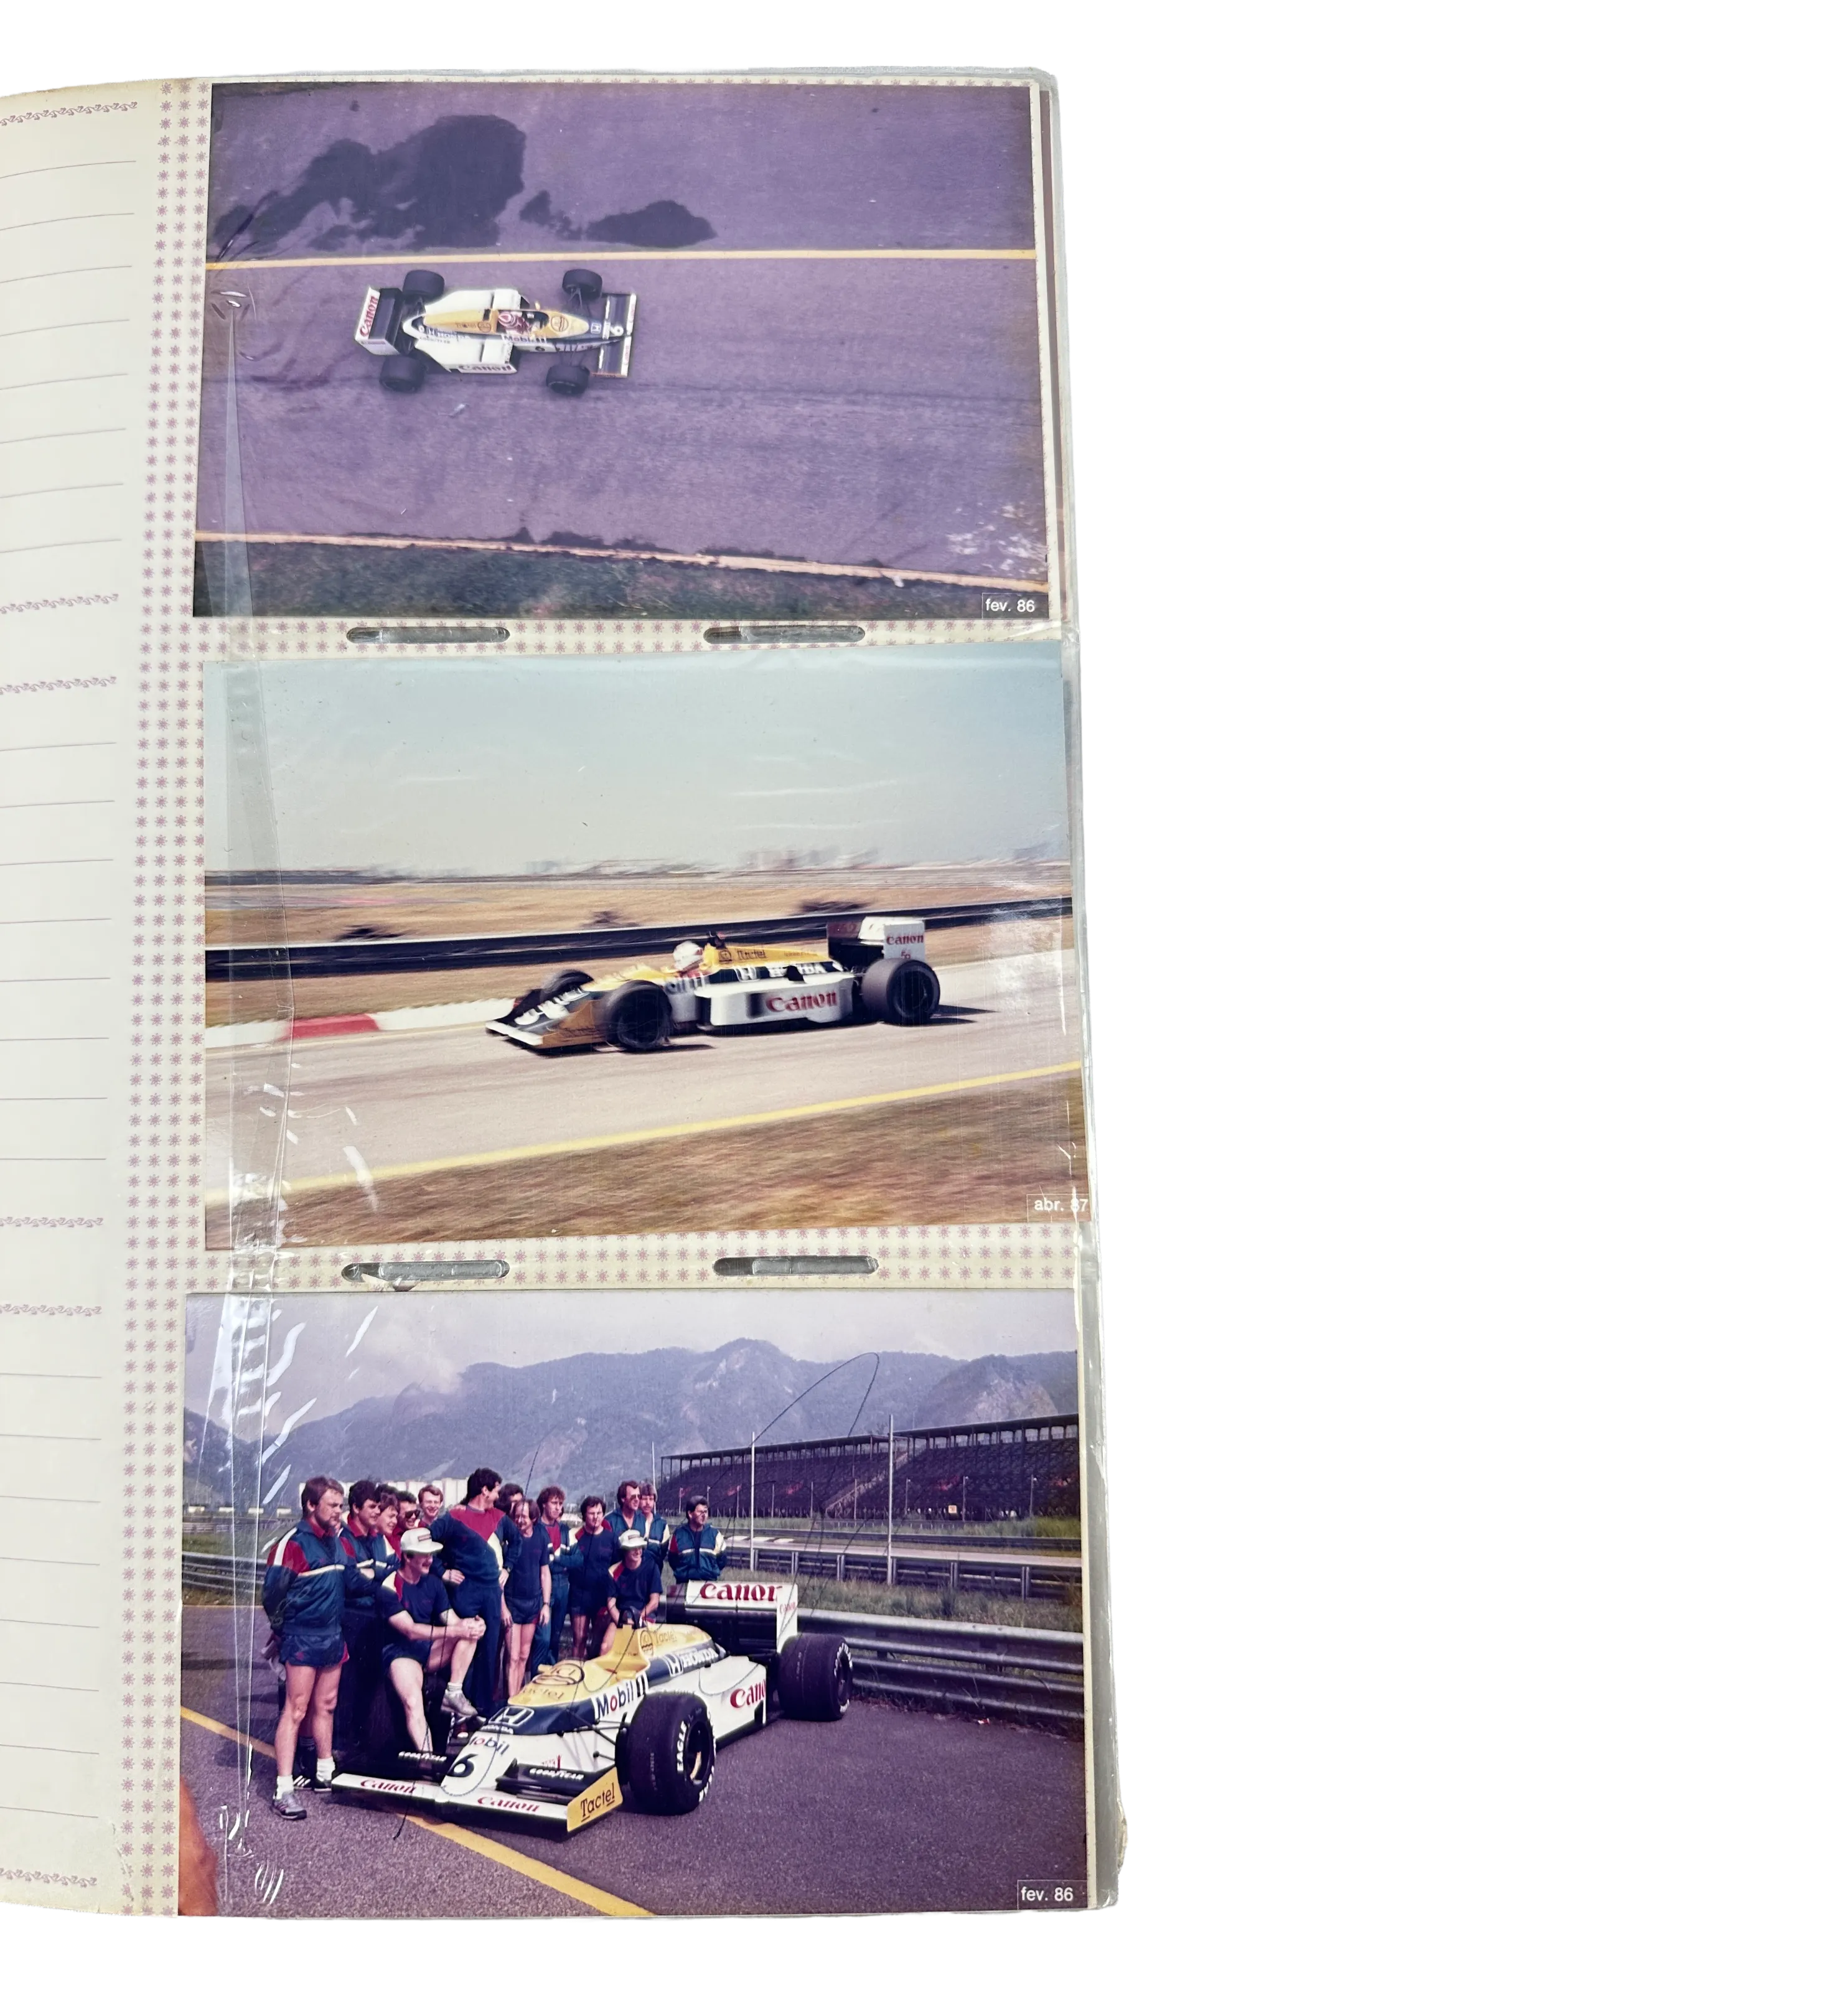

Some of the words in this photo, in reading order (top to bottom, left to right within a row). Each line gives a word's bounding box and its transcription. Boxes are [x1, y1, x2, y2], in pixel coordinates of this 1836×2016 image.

[360, 296, 378, 337] Canon
[886, 935, 924, 945] Canon
[766, 992, 838, 1013] Canon
[679, 1647, 719, 1668] HONDA
[596, 1680, 634, 1720] Mobil
[730, 1678, 766, 1709] Cano
[677, 1720, 687, 1772] EAGLE
[447, 1753, 479, 1778] 6
[529, 1768, 584, 1780] GOODYEAR
[360, 1778, 416, 1794] Canon
[477, 1796, 540, 1813] Canon
[580, 1783, 616, 1819] Tactel
